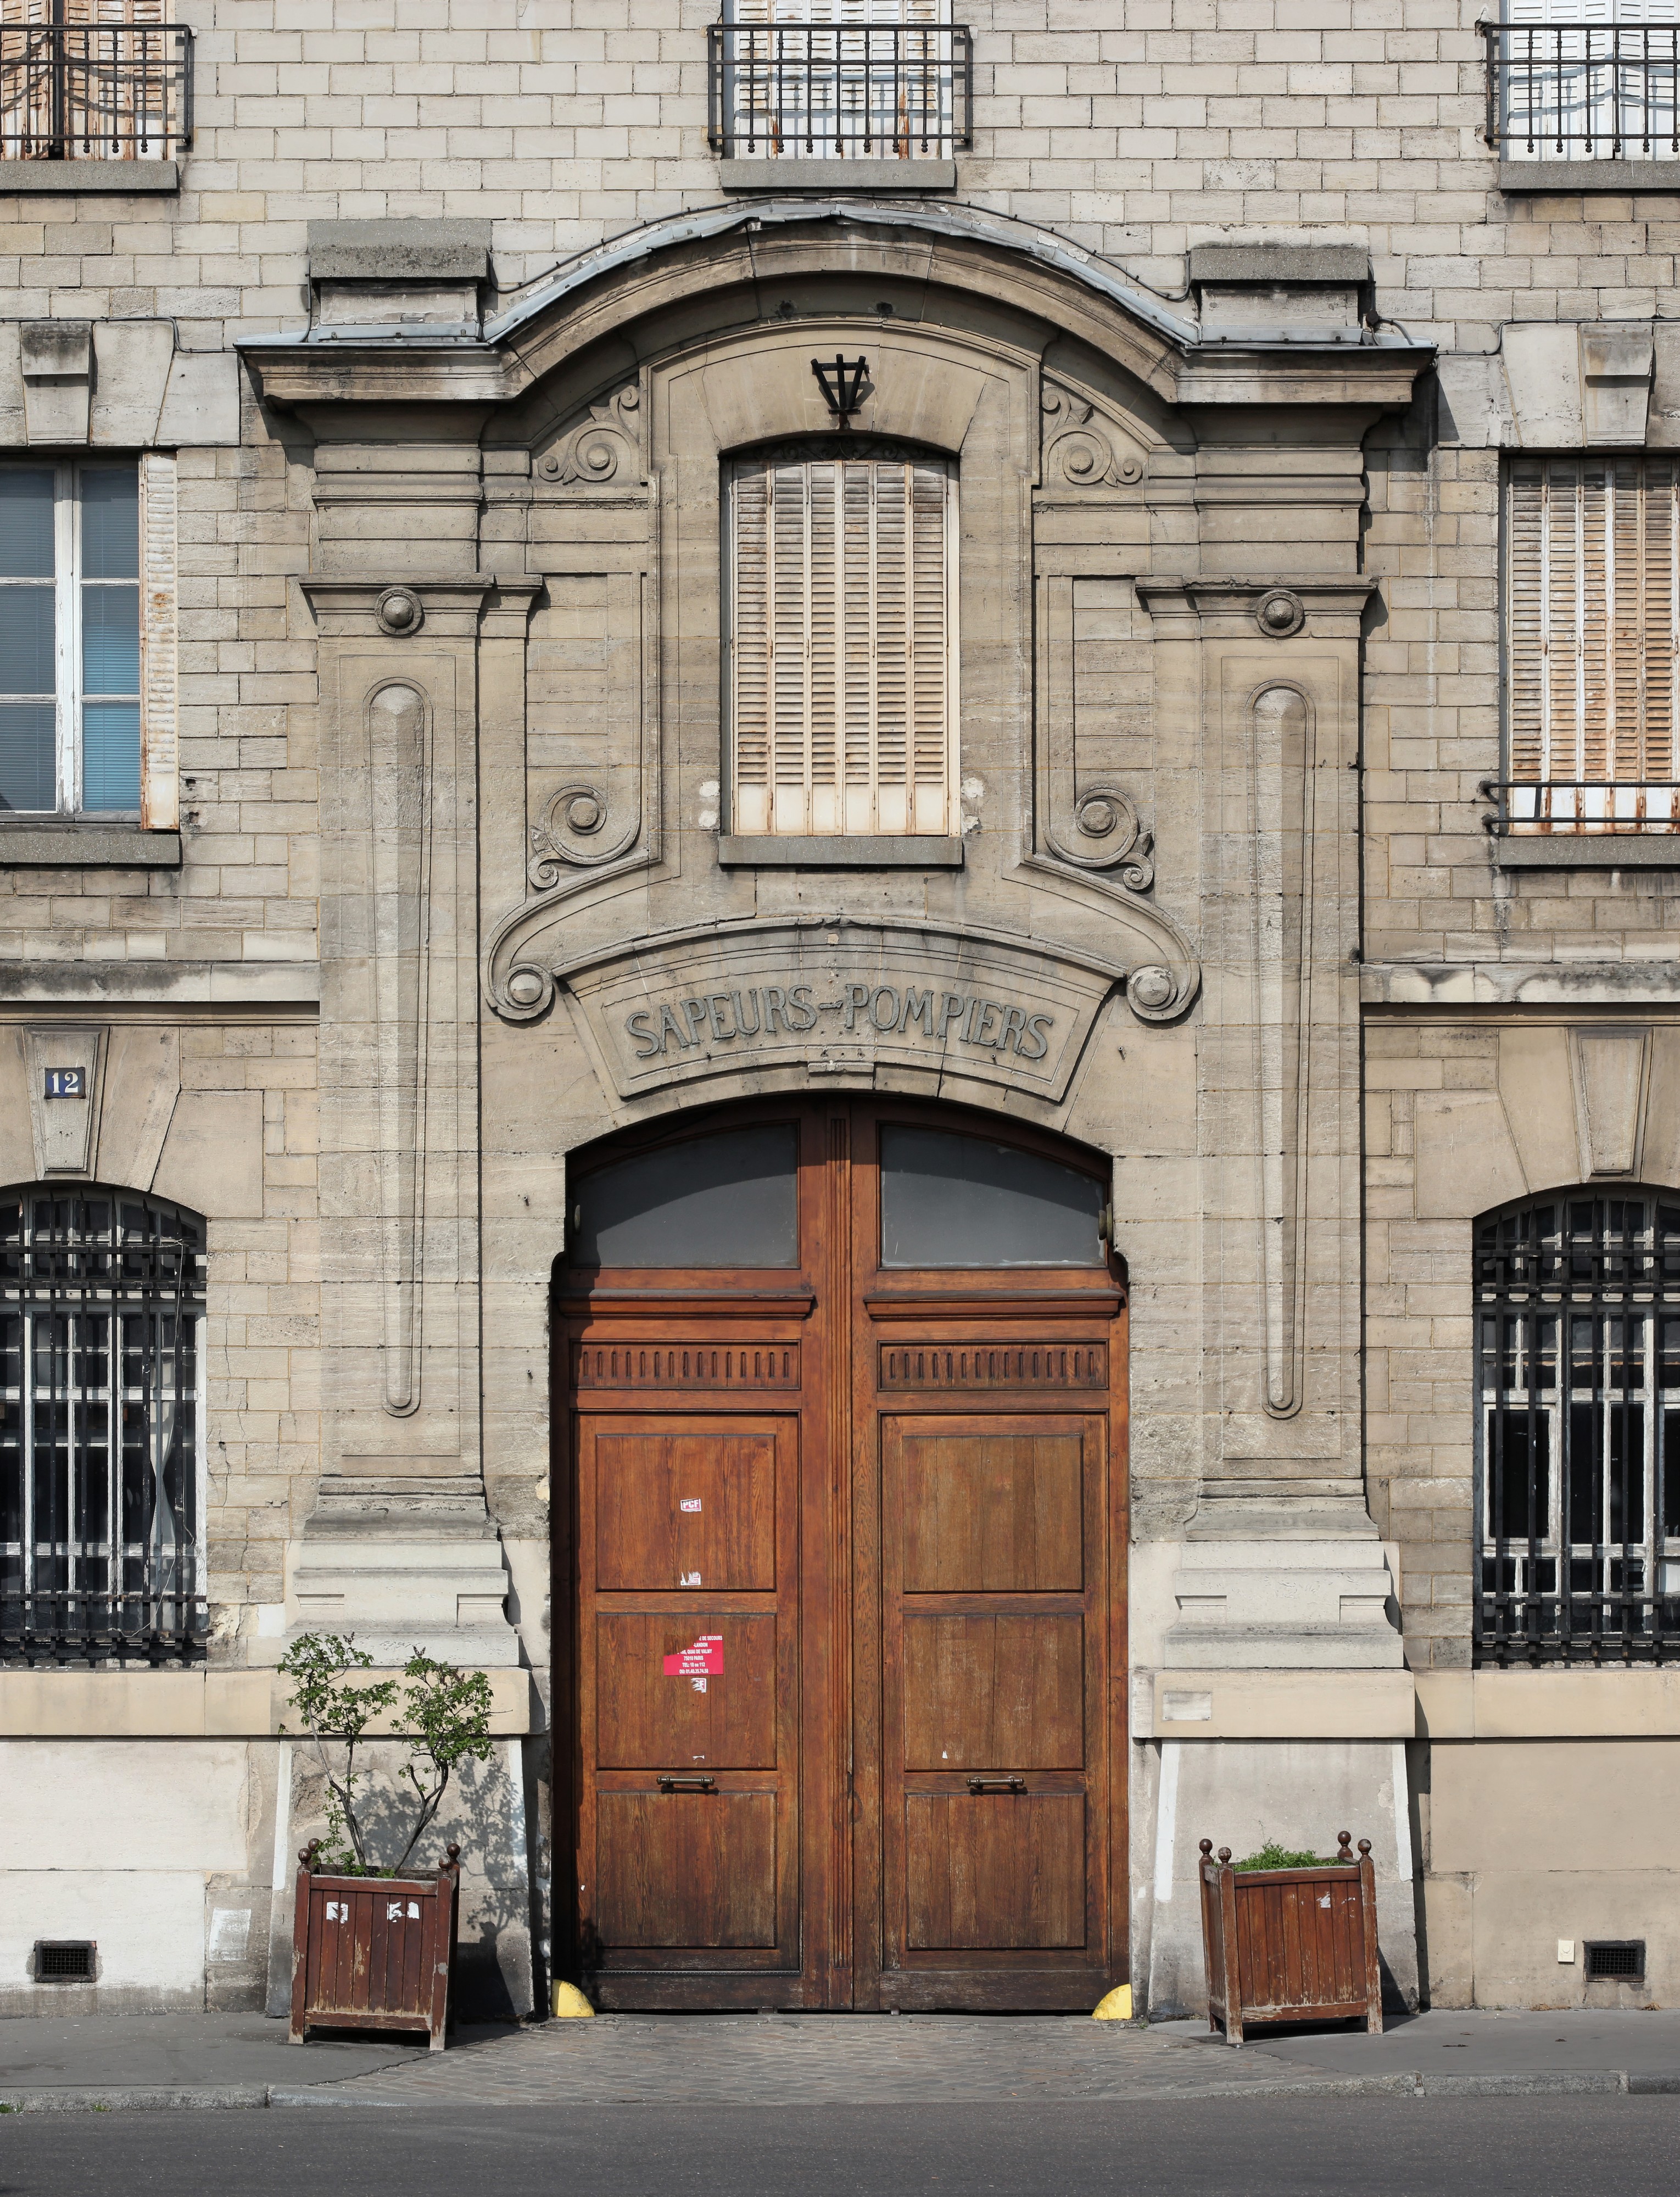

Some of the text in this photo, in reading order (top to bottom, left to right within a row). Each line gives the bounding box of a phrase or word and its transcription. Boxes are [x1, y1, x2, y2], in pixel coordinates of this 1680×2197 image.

[626, 983, 1054, 1060] SAPEURS-POMPIERS
[52, 1072, 78, 1093] 12
[683, 1499, 699, 1509] PCF
